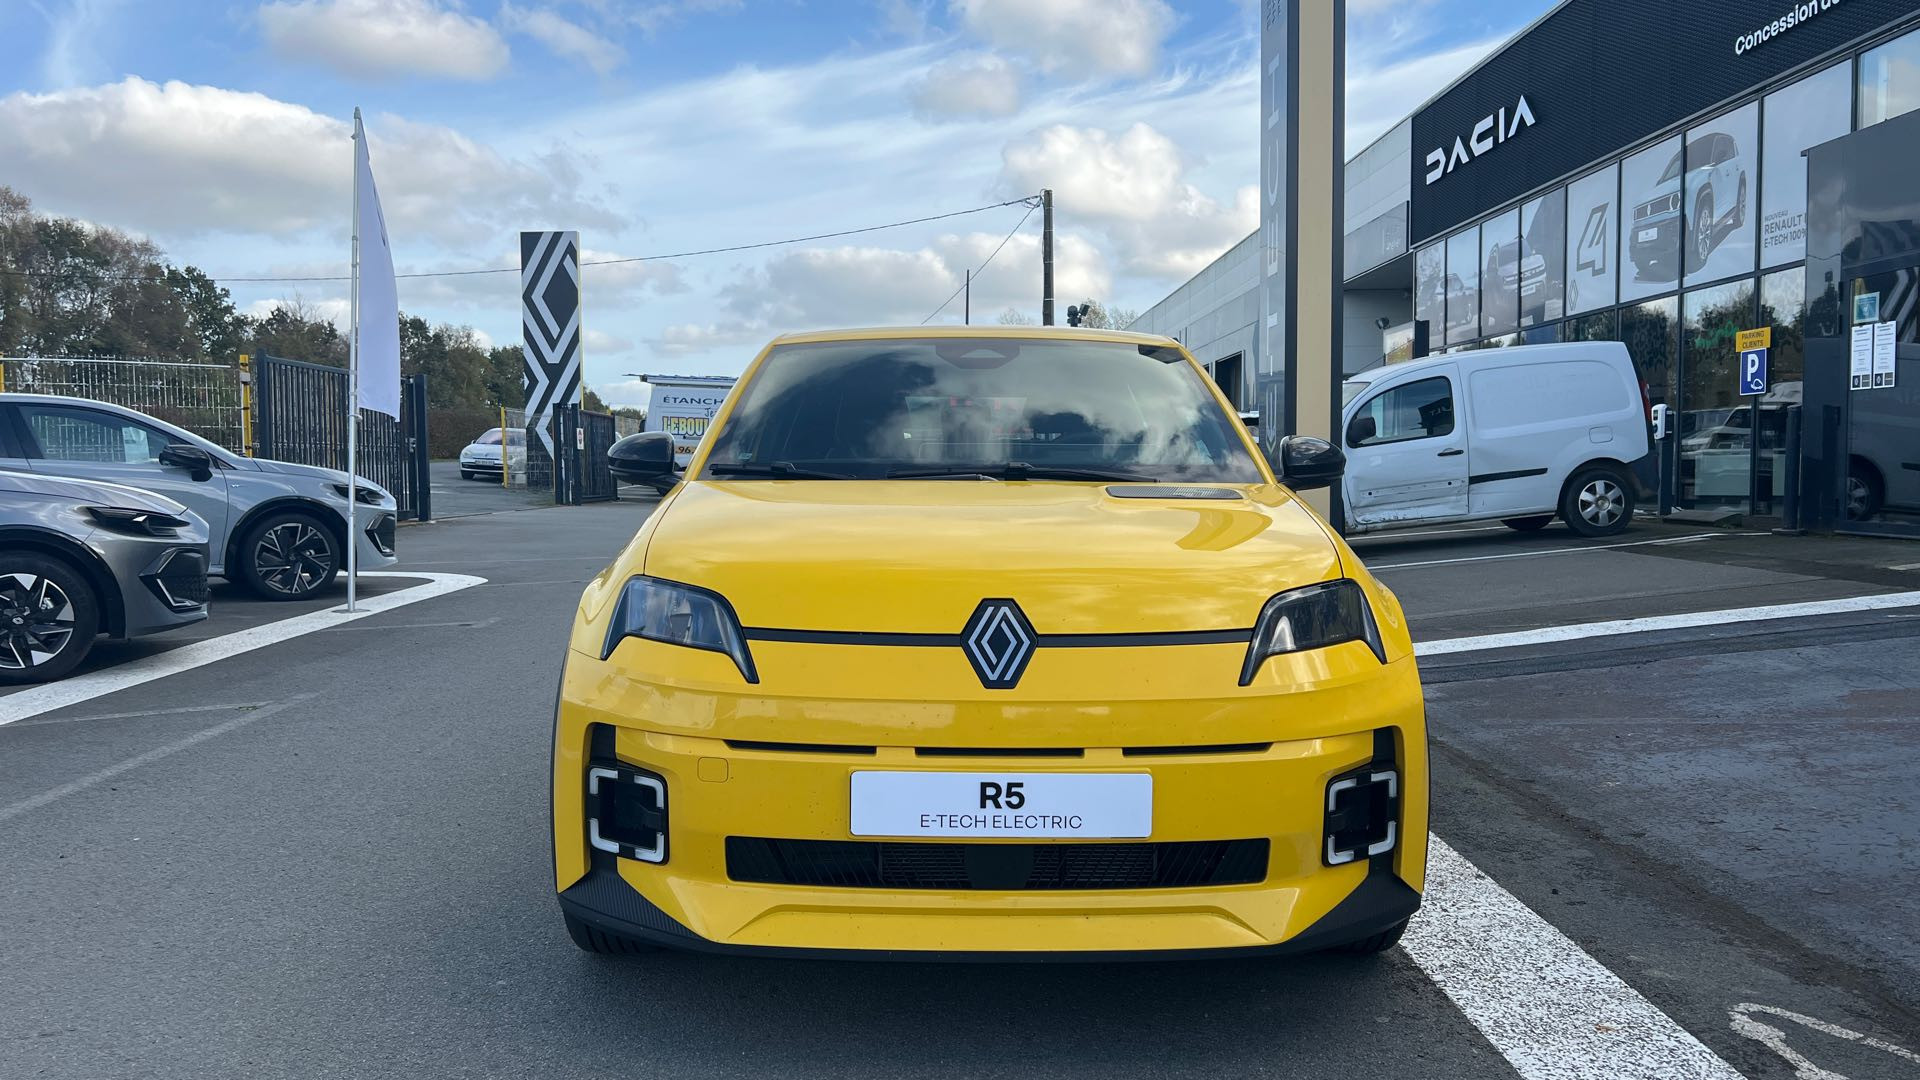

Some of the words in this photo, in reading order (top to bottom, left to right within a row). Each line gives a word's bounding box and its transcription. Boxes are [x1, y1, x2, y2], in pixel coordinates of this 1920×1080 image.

[1735, 0, 1818, 55] Concession
[1425, 94, 1536, 186] DACIA
[1764, 214, 1803, 235] RENAULT
[1764, 233, 1789, 248] E-TECH
[1742, 331, 1764, 340] PARKING
[1743, 340, 1763, 349] CLIENTS
[1747, 353, 1759, 382] P
[979, 781, 1026, 809] R5
[920, 814, 987, 828] E-TECH
[992, 814, 1083, 829] ELECTRIC
